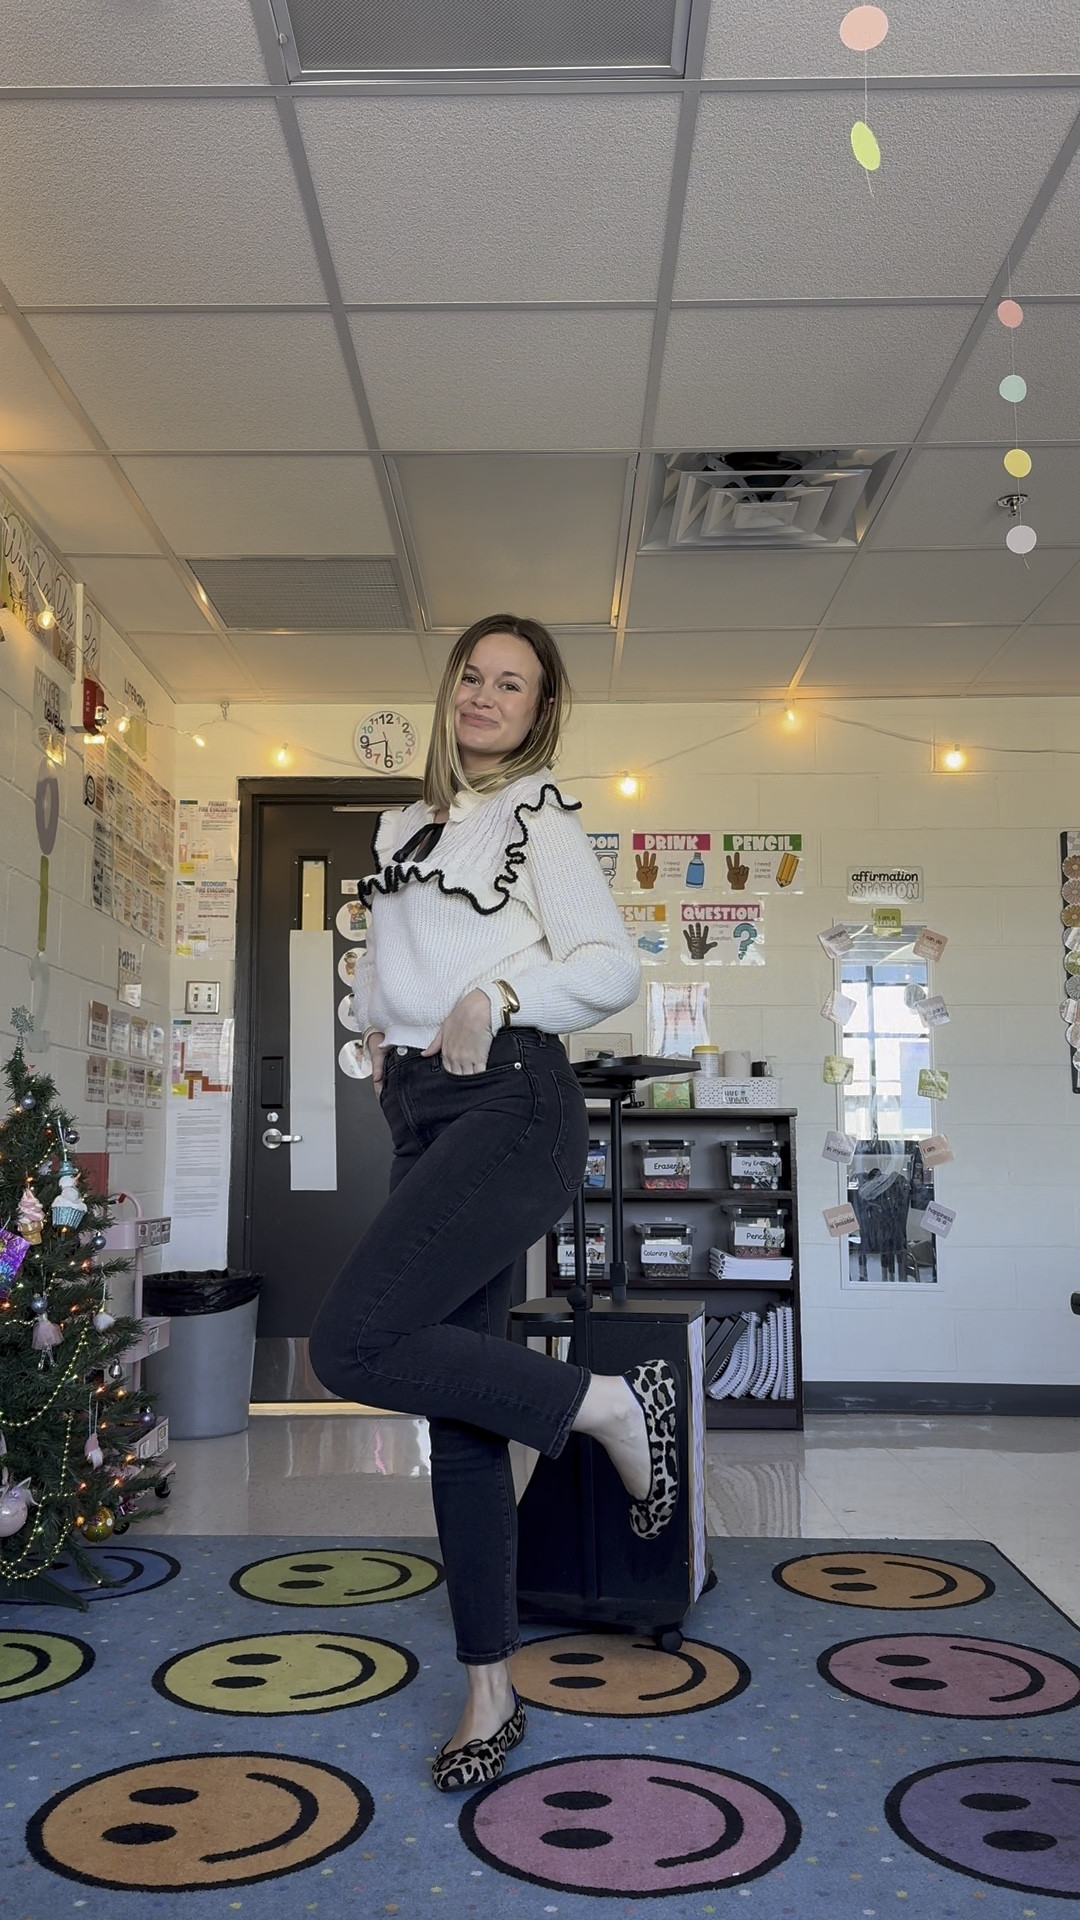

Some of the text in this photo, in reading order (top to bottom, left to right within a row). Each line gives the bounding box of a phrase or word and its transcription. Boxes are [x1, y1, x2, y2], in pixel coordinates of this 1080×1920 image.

[379, 713, 394, 725] 12
[395, 716, 401, 725] 1
[361, 725, 374, 734] 10
[401, 722, 410, 733] 2
[360, 735, 370, 749] 9
[405, 733, 415, 747] 3
[365, 748, 373, 759] 8
[395, 751, 404, 764] 5
[405, 748, 412, 756] 4
[373, 753, 381, 764] 7
[384, 754, 394, 768] 6
[645, 835, 698, 850] DRINK
[732, 836, 792, 850] PENCIL
[851, 871, 918, 881] affirmation
[852, 882, 919, 899] STATION
[683, 907, 759, 920] QUESTION
[643, 1250, 668, 1258] Coloring
